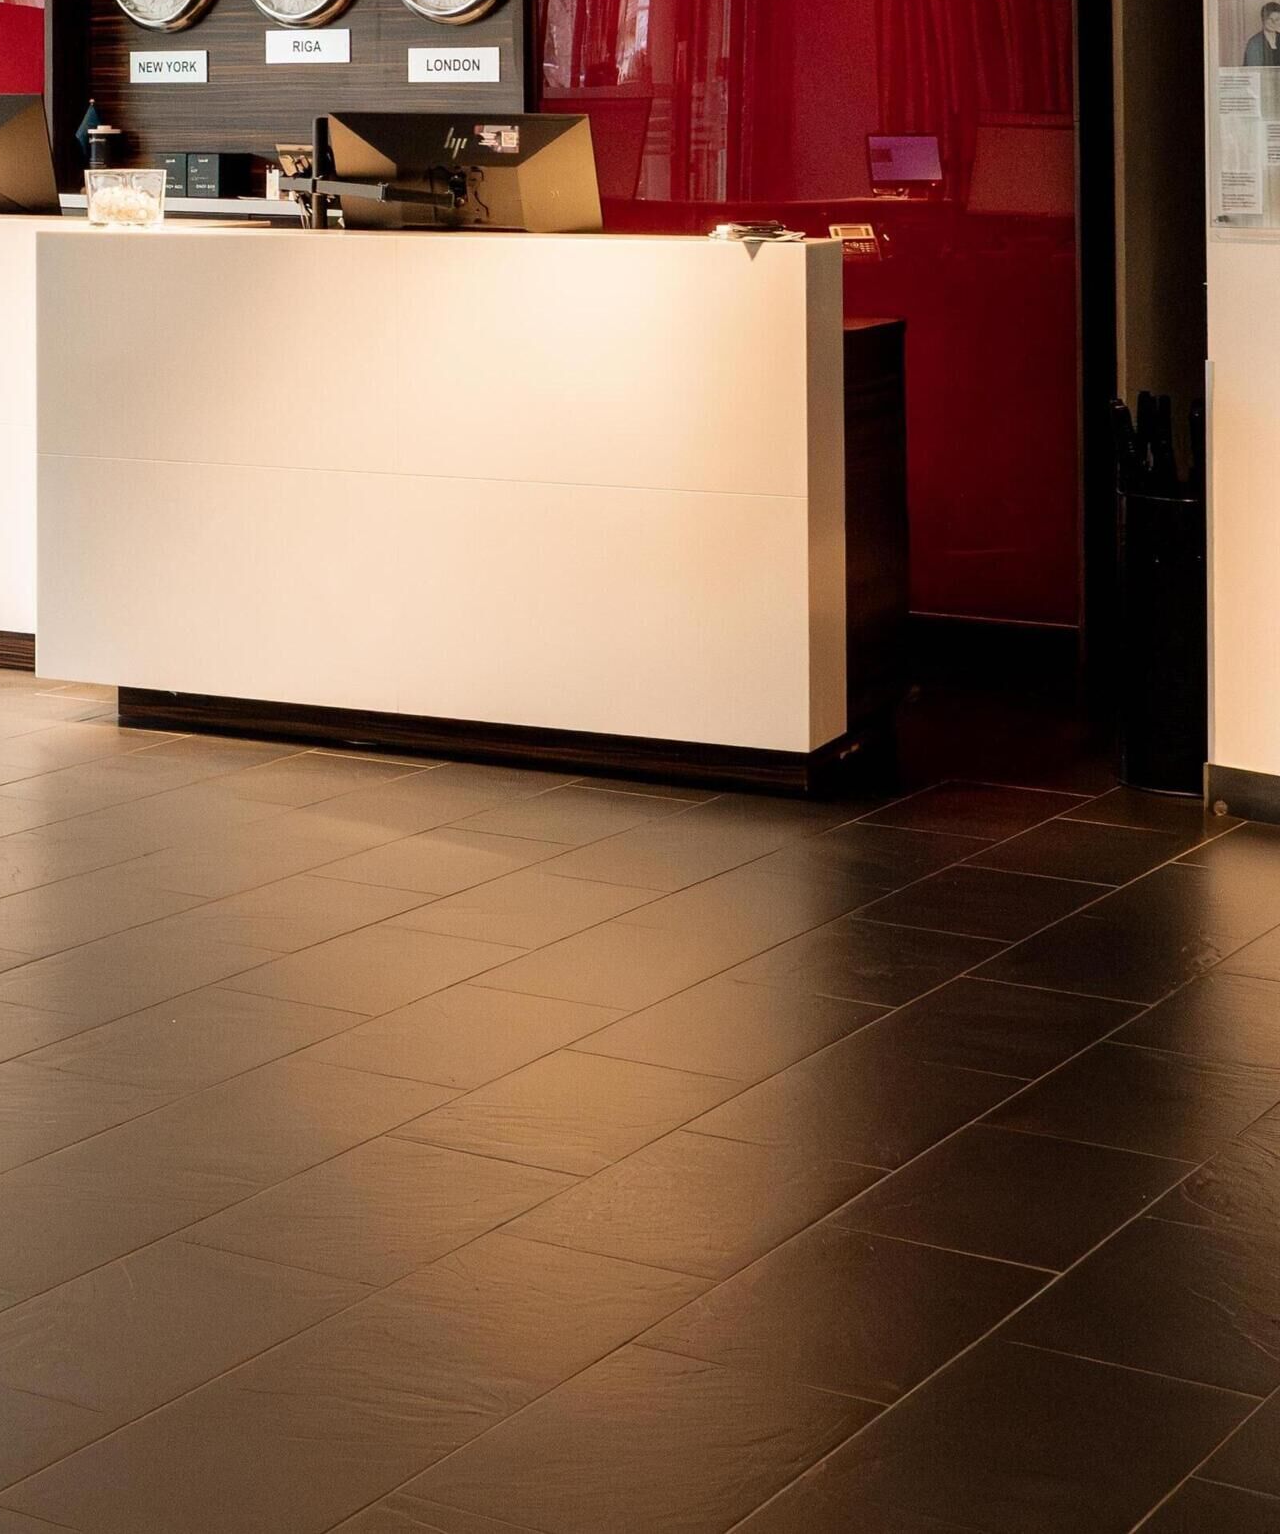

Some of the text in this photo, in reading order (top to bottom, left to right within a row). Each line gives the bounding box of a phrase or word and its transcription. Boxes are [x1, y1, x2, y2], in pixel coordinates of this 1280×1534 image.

[292, 40, 322, 53] RIGA
[138, 61, 197, 73] NEW YORK
[426, 59, 481, 71] LONDON
